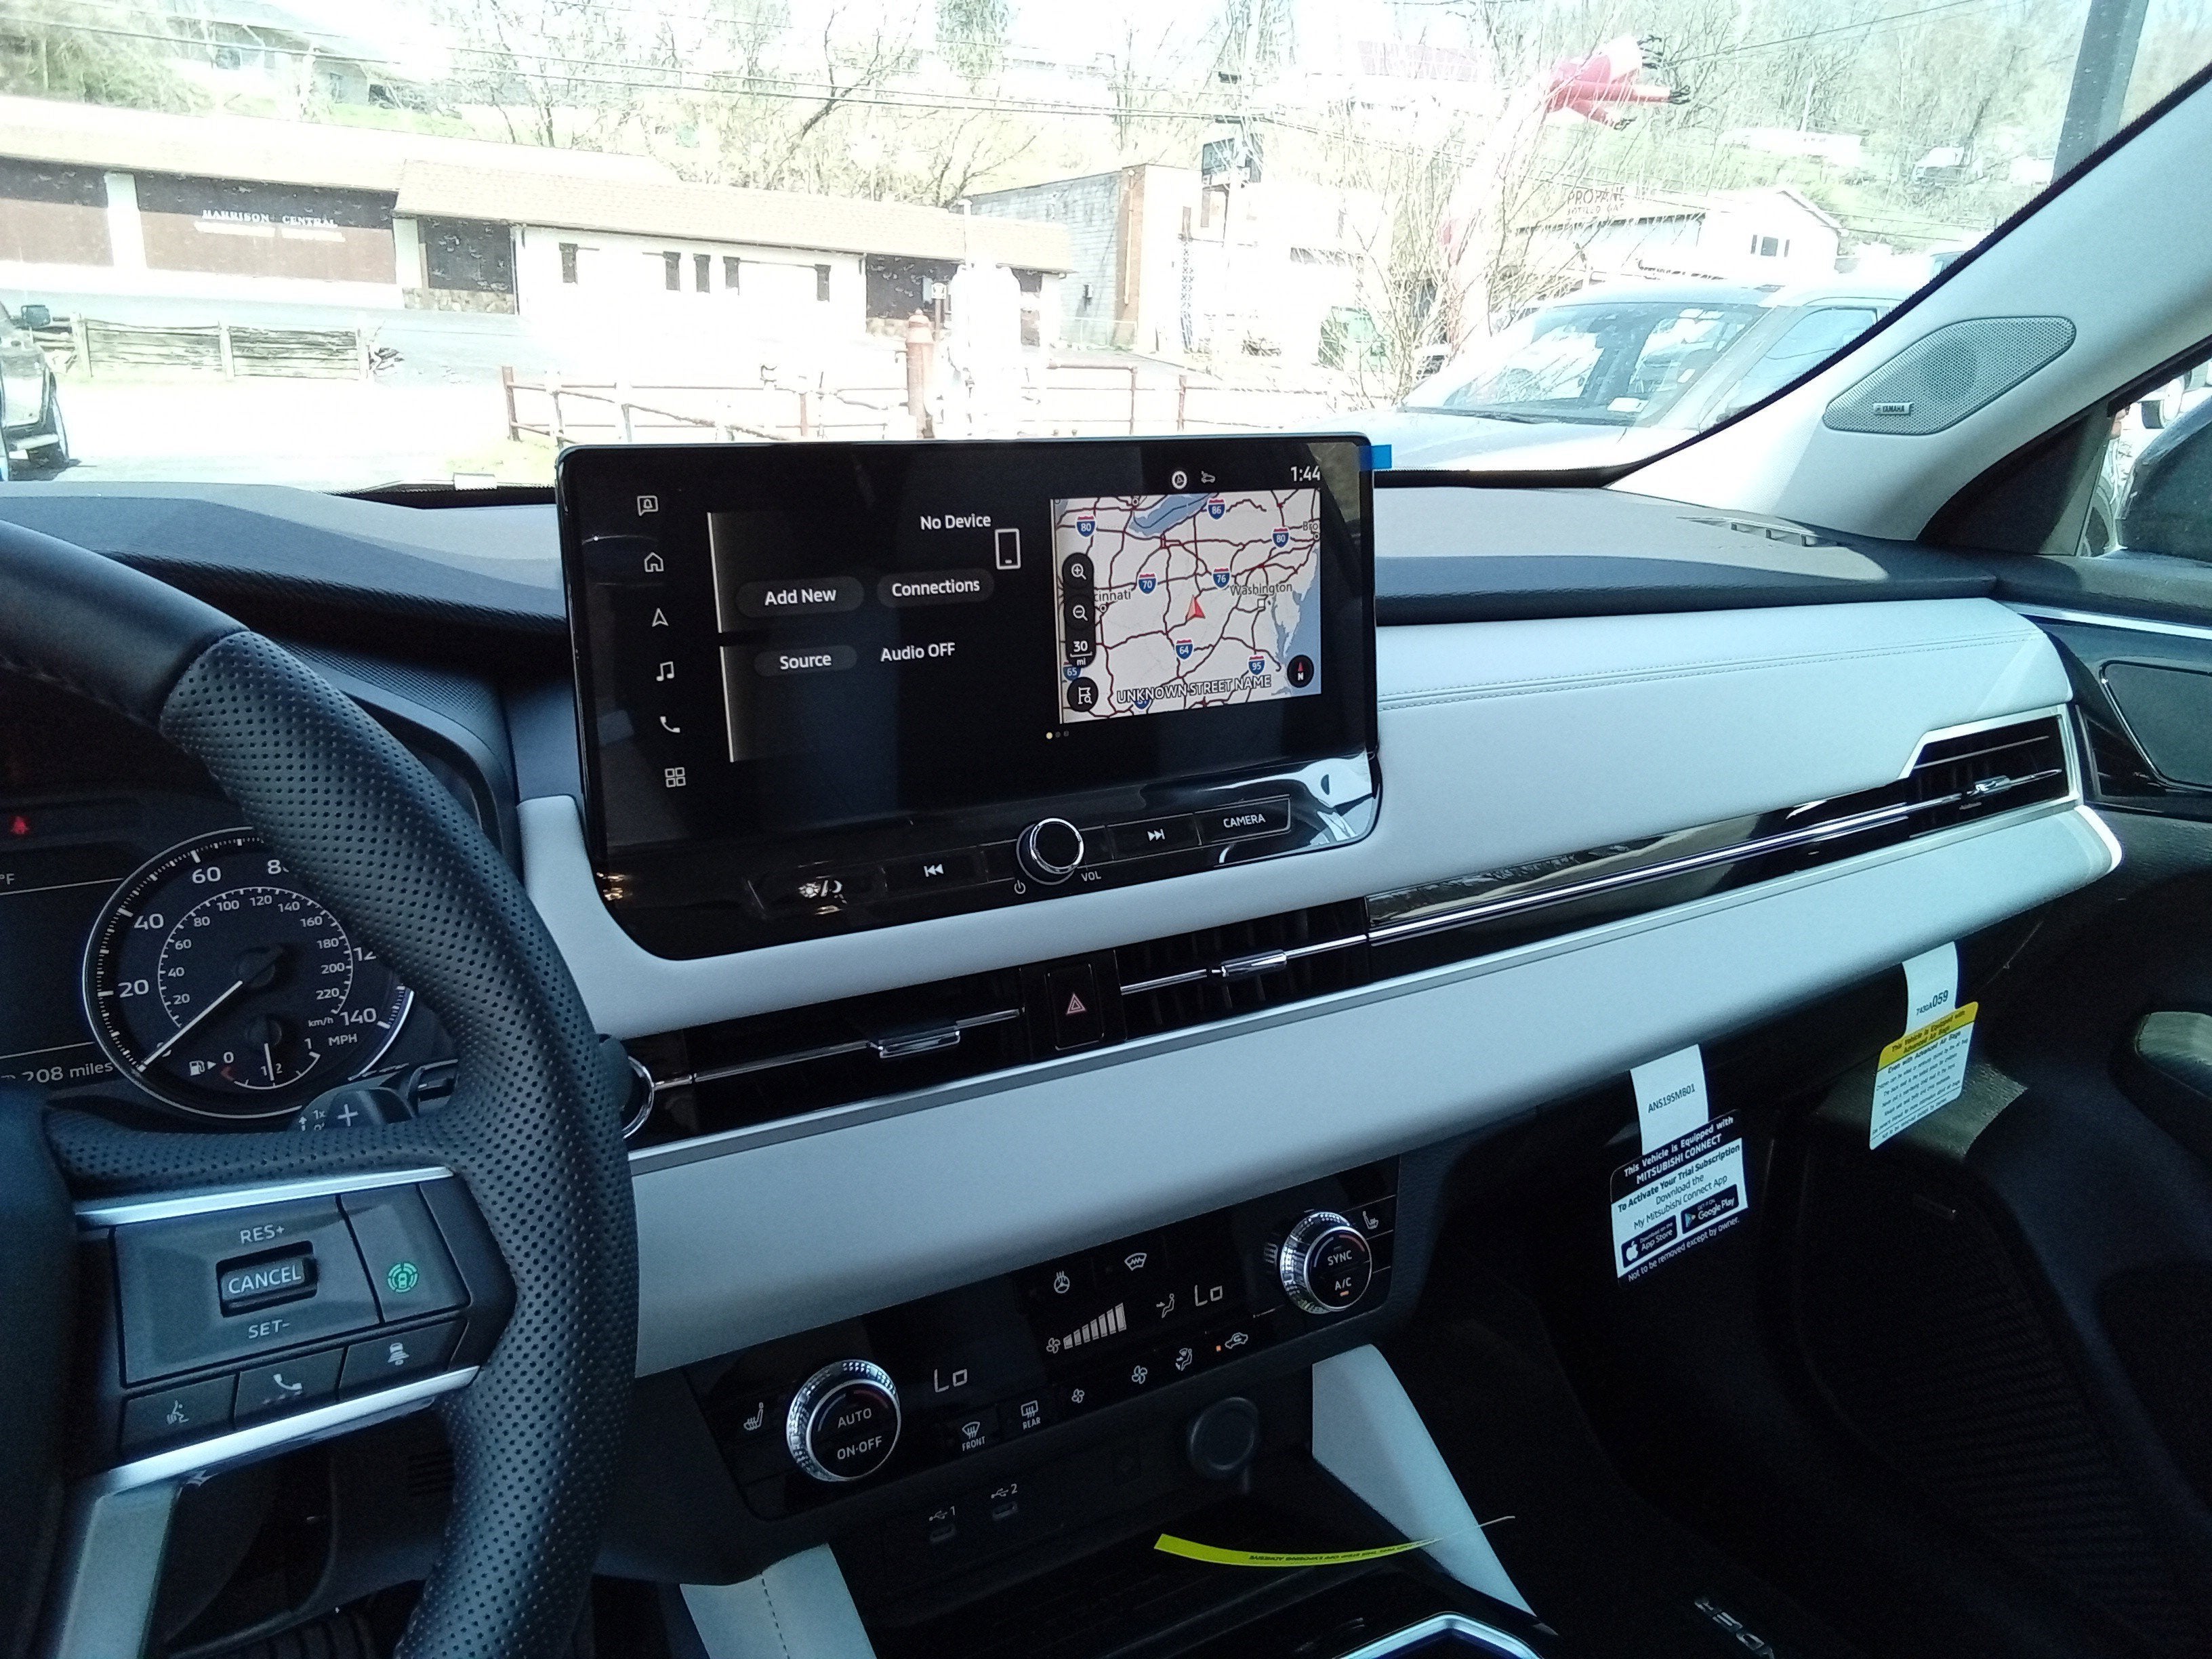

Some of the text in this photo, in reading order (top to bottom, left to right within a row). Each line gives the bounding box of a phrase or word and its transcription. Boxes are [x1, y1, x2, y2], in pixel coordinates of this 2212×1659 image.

[281, 216, 338, 228] CENTRAL
[1290, 465, 1321, 482] 1:44
[1212, 506, 1223, 514] 86
[920, 514, 991, 531] No Device
[1080, 523, 1092, 532] 80
[1276, 534, 1286, 544] 80
[1142, 580, 1153, 589] 70
[1216, 574, 1227, 583] 76
[891, 578, 981, 597] Connections
[1230, 581, 1293, 598] Washington
[764, 588, 837, 606] Add New
[880, 642, 956, 662] Audio OFF
[1073, 640, 1088, 653] 30
[1179, 645, 1189, 654] 64
[779, 653, 832, 670] Source
[1076, 657, 1086, 666] mi
[1252, 662, 1262, 671] 95
[1067, 667, 1078, 676] 65
[1117, 684, 1187, 704] UNKNOWN
[1189, 678, 1233, 697] STREET
[1234, 674, 1272, 692] NAME
[1223, 813, 1266, 828] CAMERA
[267, 859, 289, 874] 8
[192, 866, 221, 884] 60
[1081, 870, 1102, 882] VOL
[216, 900, 240, 912] 100
[249, 895, 272, 907] 120
[278, 901, 300, 912] 140
[134, 913, 164, 930] 40
[193, 916, 211, 927] 80
[300, 916, 323, 928] 160
[175, 939, 192, 950] 60
[316, 937, 339, 949] 180
[168, 966, 185, 978] 40
[321, 962, 345, 975] 200
[118, 979, 149, 998] 20
[316, 987, 340, 1000] 220
[173, 993, 190, 1005] 20
[308, 1016, 333, 1027] km/h
[340, 1008, 377, 1026] 140
[304, 1038, 312, 1049] 1
[329, 1033, 357, 1046] MPH
[224, 1051, 234, 1064] 0
[70, 1062, 114, 1078] miles
[1624, 1114, 1733, 1177] This Vehicle is Equipped with
[1636, 1132, 1721, 1185] MITSUBISHI CONNECT
[1618, 1142, 1740, 1212] To Activate Your Trial Subscription
[1656, 1172, 1704, 1205] Download the
[1634, 1173, 1727, 1231] My Mitsubishi Connect App
[1698, 1194, 1734, 1223] Google Play
[240, 1224, 286, 1244] RES+
[1641, 1227, 1673, 1252] App Store
[1628, 1215, 1739, 1282] Not to be removed except by owner.
[1327, 1250, 1353, 1266] SYNC
[228, 1265, 302, 1294] CANCEL
[1334, 1277, 1352, 1291] A/C
[1194, 1285, 1223, 1307] Lo
[247, 1319, 290, 1340] SET-
[934, 1368, 968, 1393] Lo
[837, 1408, 872, 1429] AUTO
[1022, 1416, 1041, 1430] REAR
[962, 1435, 985, 1452] FRONT
